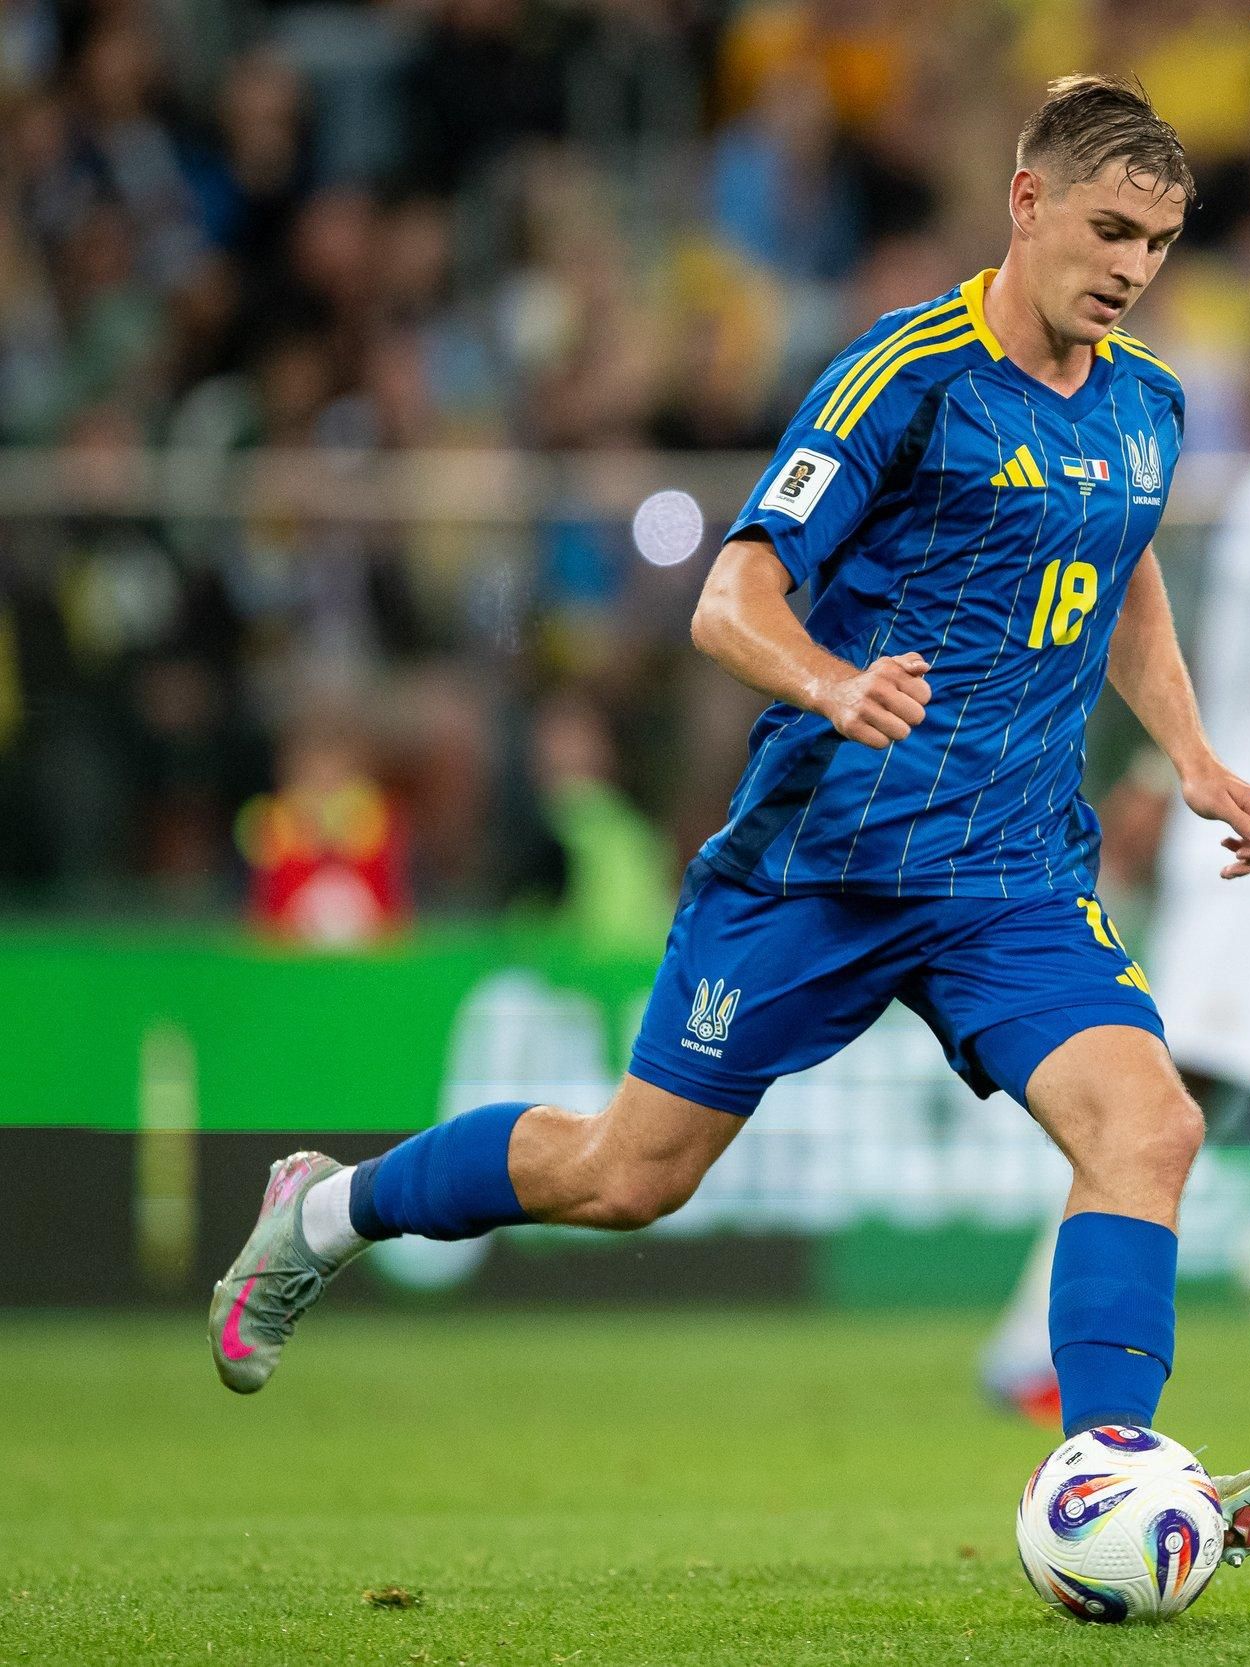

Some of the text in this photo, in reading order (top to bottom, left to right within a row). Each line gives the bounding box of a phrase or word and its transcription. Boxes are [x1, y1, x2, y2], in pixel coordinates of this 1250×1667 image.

[1132, 495, 1160, 506] UKRAINE
[1027, 559, 1098, 649] 18
[681, 1037, 724, 1058] UKRAINE
